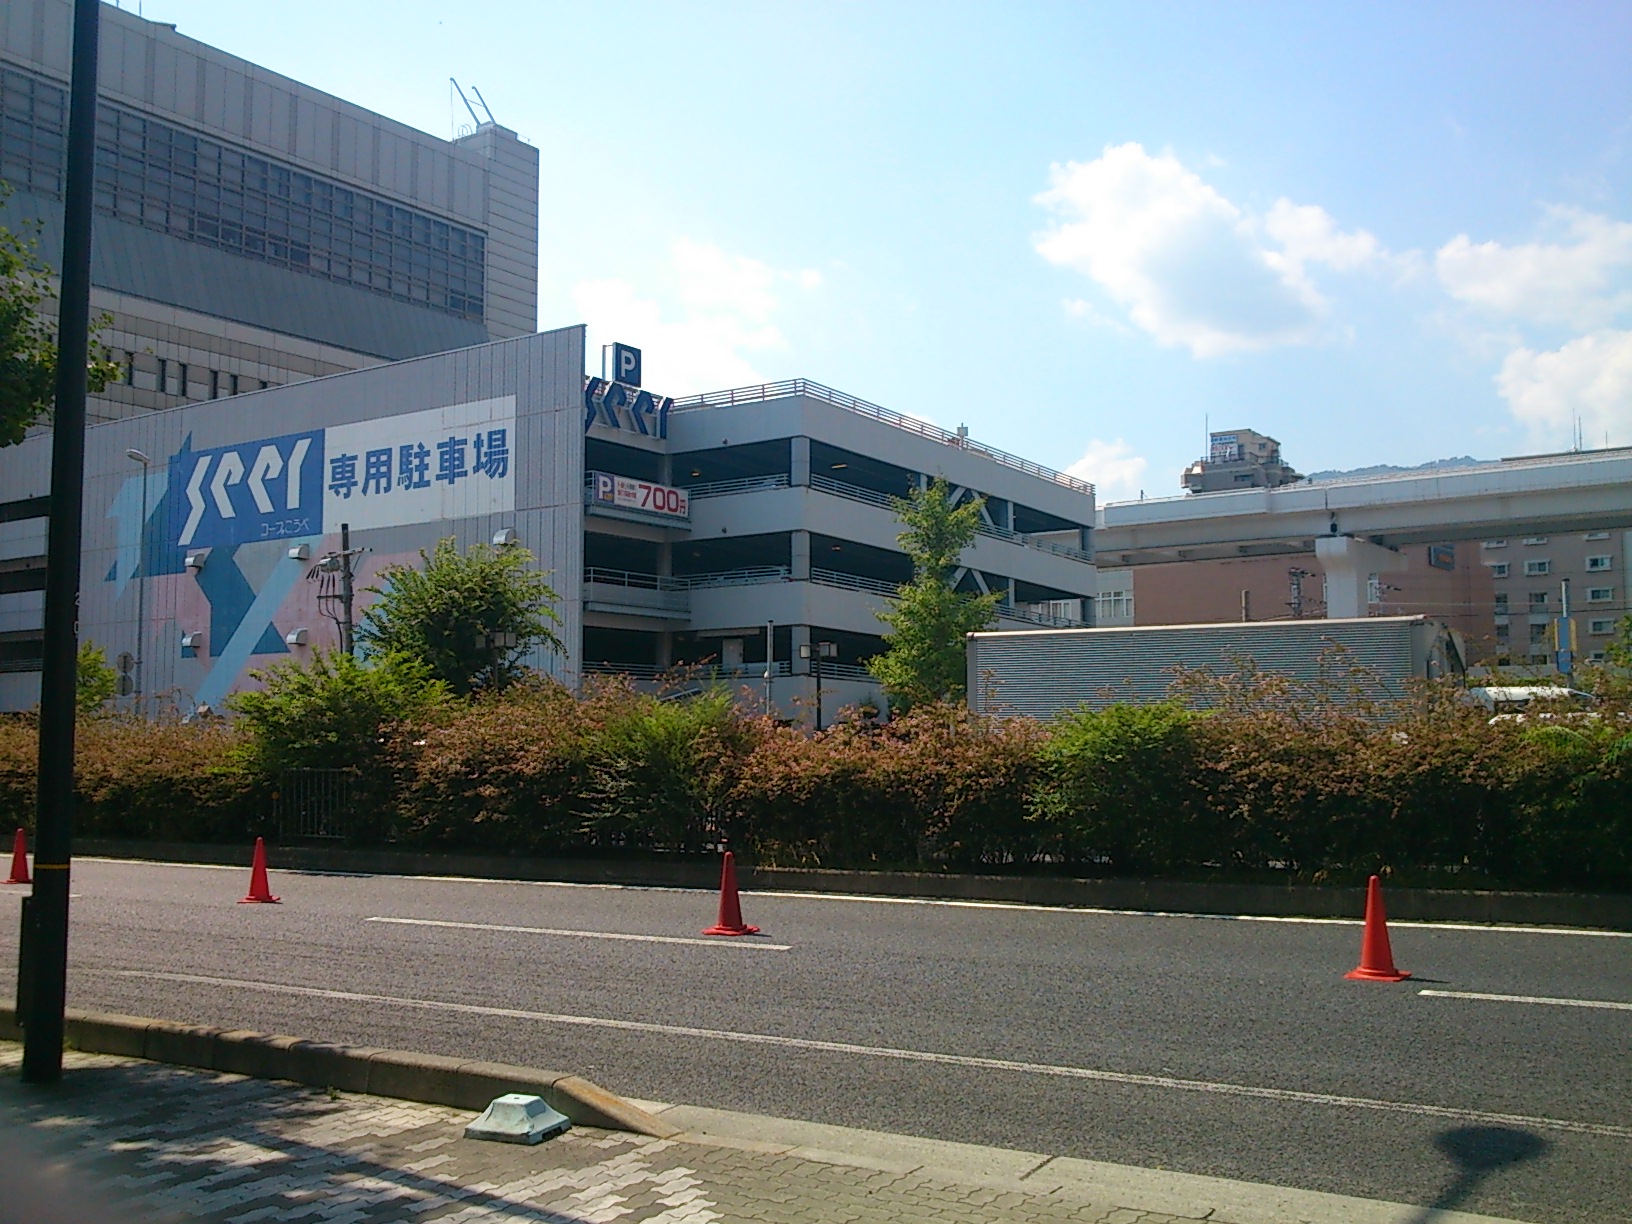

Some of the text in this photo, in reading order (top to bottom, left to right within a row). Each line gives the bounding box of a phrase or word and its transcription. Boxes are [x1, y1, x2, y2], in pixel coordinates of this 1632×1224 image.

[620, 349, 636, 379] P
[328, 429, 509, 499] 専用駐車場
[598, 475, 612, 499] P
[638, 483, 686, 515] 700円
